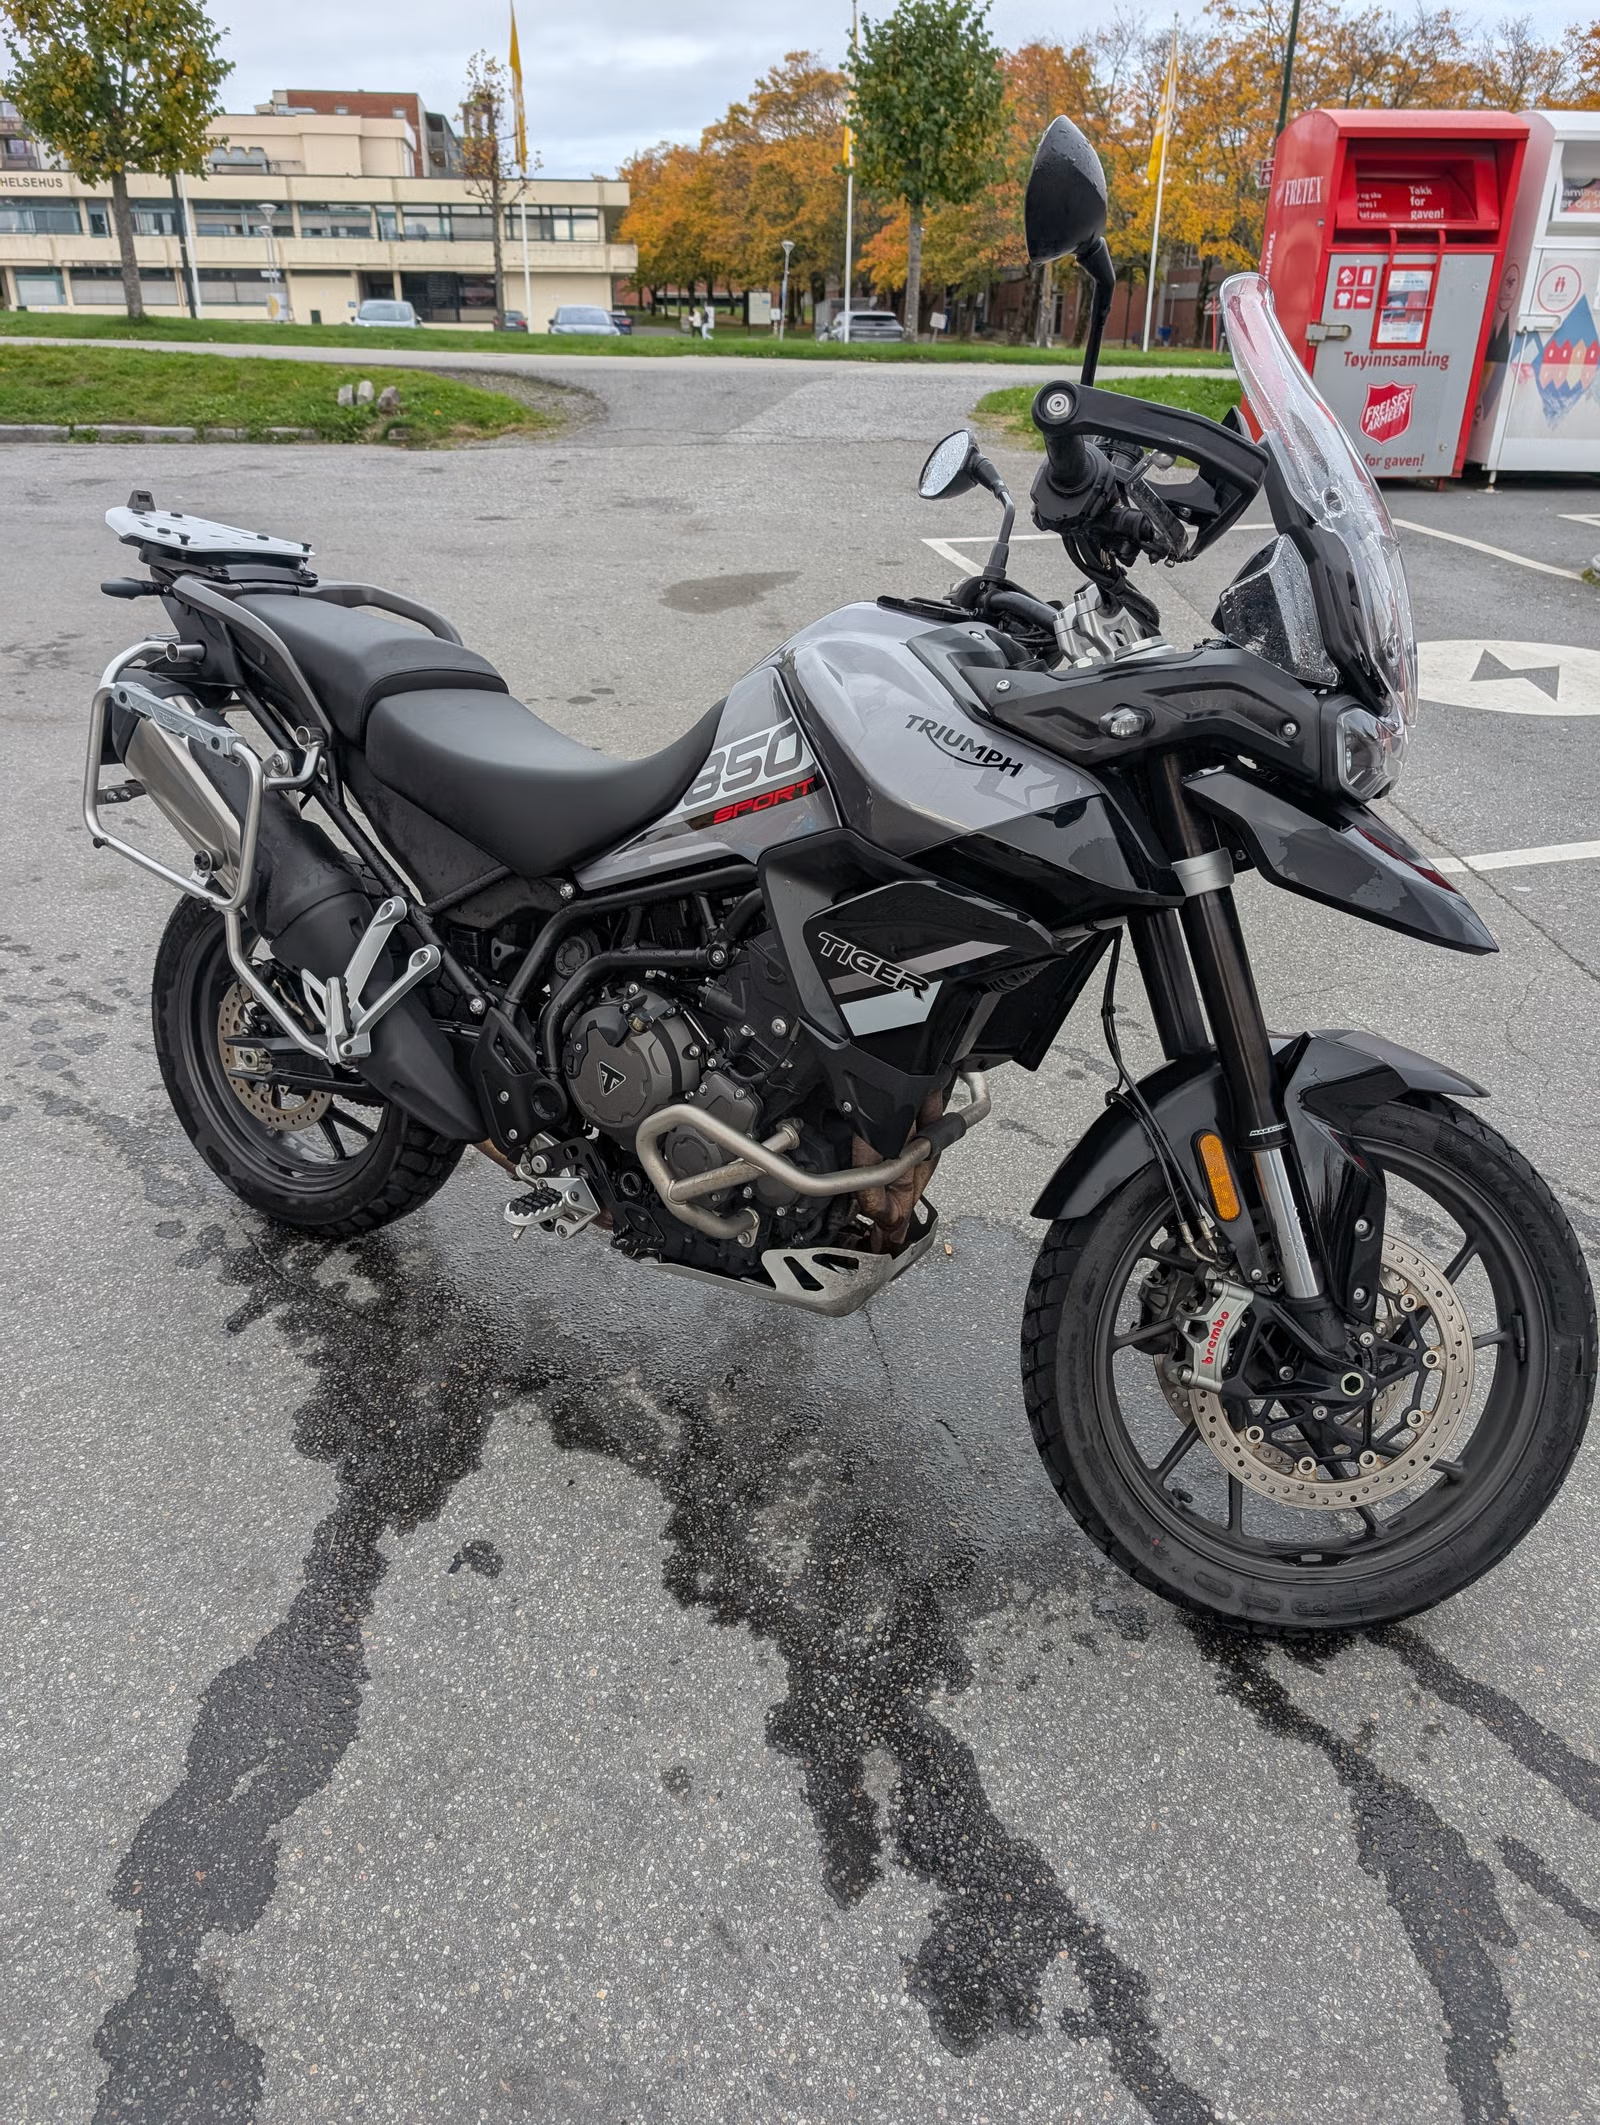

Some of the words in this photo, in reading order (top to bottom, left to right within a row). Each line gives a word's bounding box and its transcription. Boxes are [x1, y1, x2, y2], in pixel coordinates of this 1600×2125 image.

[0, 177, 63, 188] HELSEHUS
[1284, 176, 1323, 207] FRETEX
[1409, 186, 1432, 195] Takk
[1410, 196, 1425, 206] for
[1411, 208, 1444, 220] gaven!
[1344, 350, 1450, 371] Tøyinnsamling
[1366, 403, 1407, 434] ARMEEN
[1364, 453, 1382, 466] for
[1384, 453, 1425, 470] gaven!
[904, 714, 1024, 778] TRIUMPH
[683, 719, 803, 807] 850
[713, 776, 815, 825] SPORT
[818, 931, 930, 1002] TIGER
[1201, 1311, 1229, 1365] brembo
